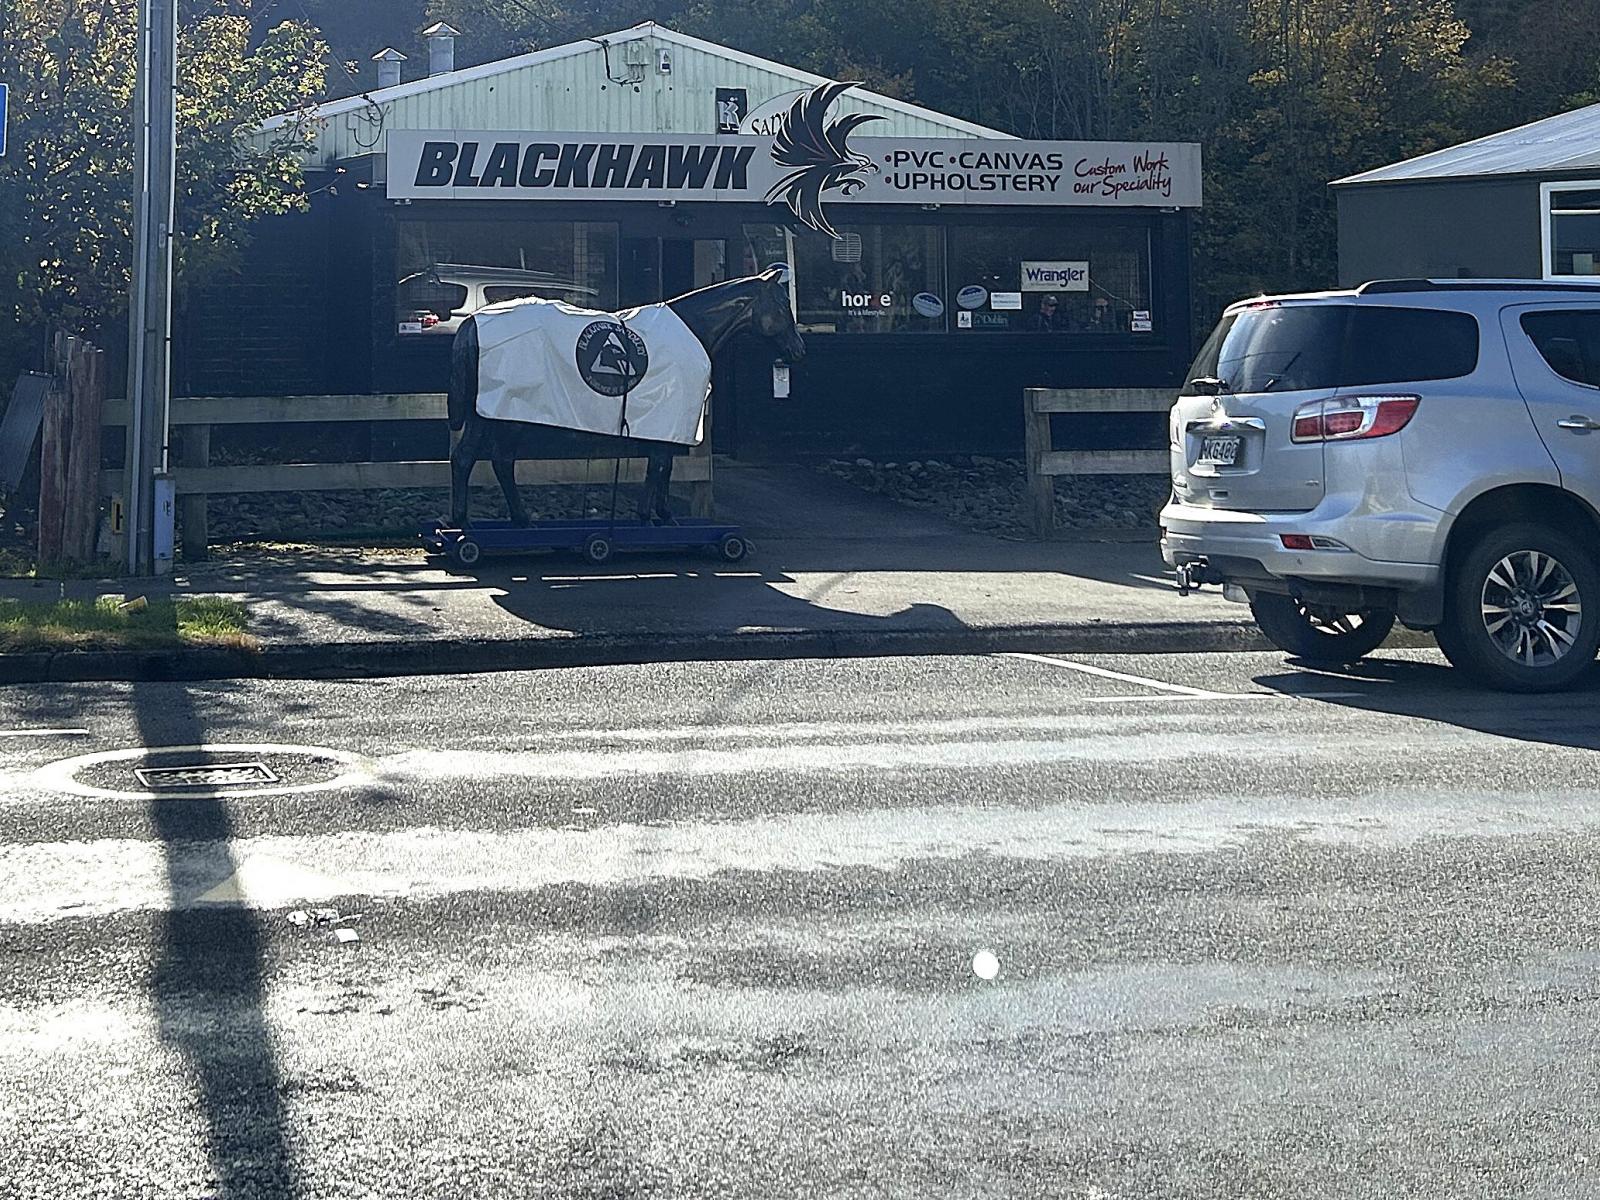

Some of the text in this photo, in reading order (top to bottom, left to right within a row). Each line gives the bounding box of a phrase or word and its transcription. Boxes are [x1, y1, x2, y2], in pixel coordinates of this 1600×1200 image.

[413, 141, 756, 190] BLACKHAWK
[893, 150, 1063, 171] PVC CANVAS
[1074, 149, 1169, 177] Custom Work
[893, 172, 1061, 192] UPHOLSTERY
[1073, 170, 1172, 199] our Speciality
[1025, 267, 1086, 287] Wrangler
[841, 290, 892, 307] hore
